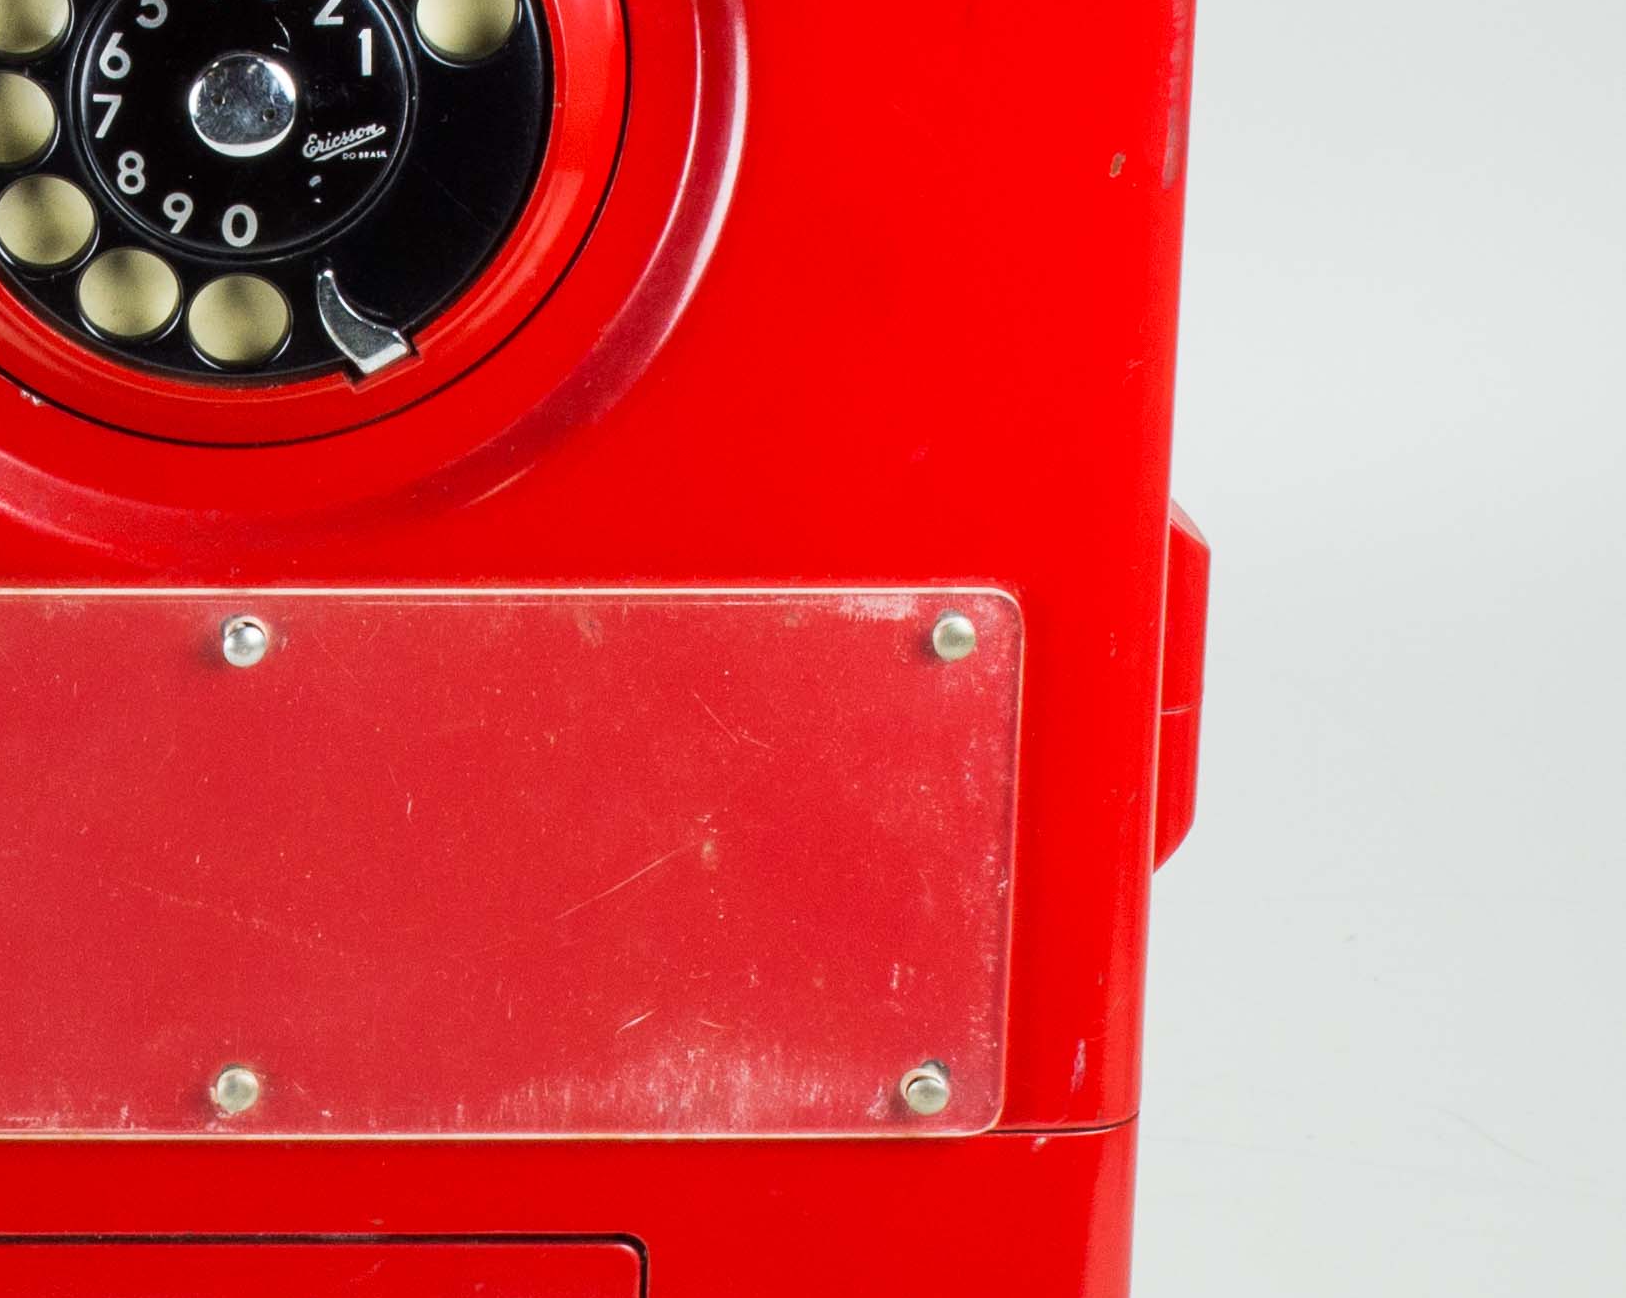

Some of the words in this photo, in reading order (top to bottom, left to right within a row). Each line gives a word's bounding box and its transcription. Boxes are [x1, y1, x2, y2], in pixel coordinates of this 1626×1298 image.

[99, 32, 132, 80] 6
[358, 28, 373, 77] 1
[92, 94, 123, 139] 7
[302, 123, 387, 161] Ericsson
[342, 152, 357, 160] DO
[358, 150, 388, 159] BRASIL
[117, 150, 146, 195] 8
[162, 192, 194, 234] 9
[222, 204, 258, 248] 0
